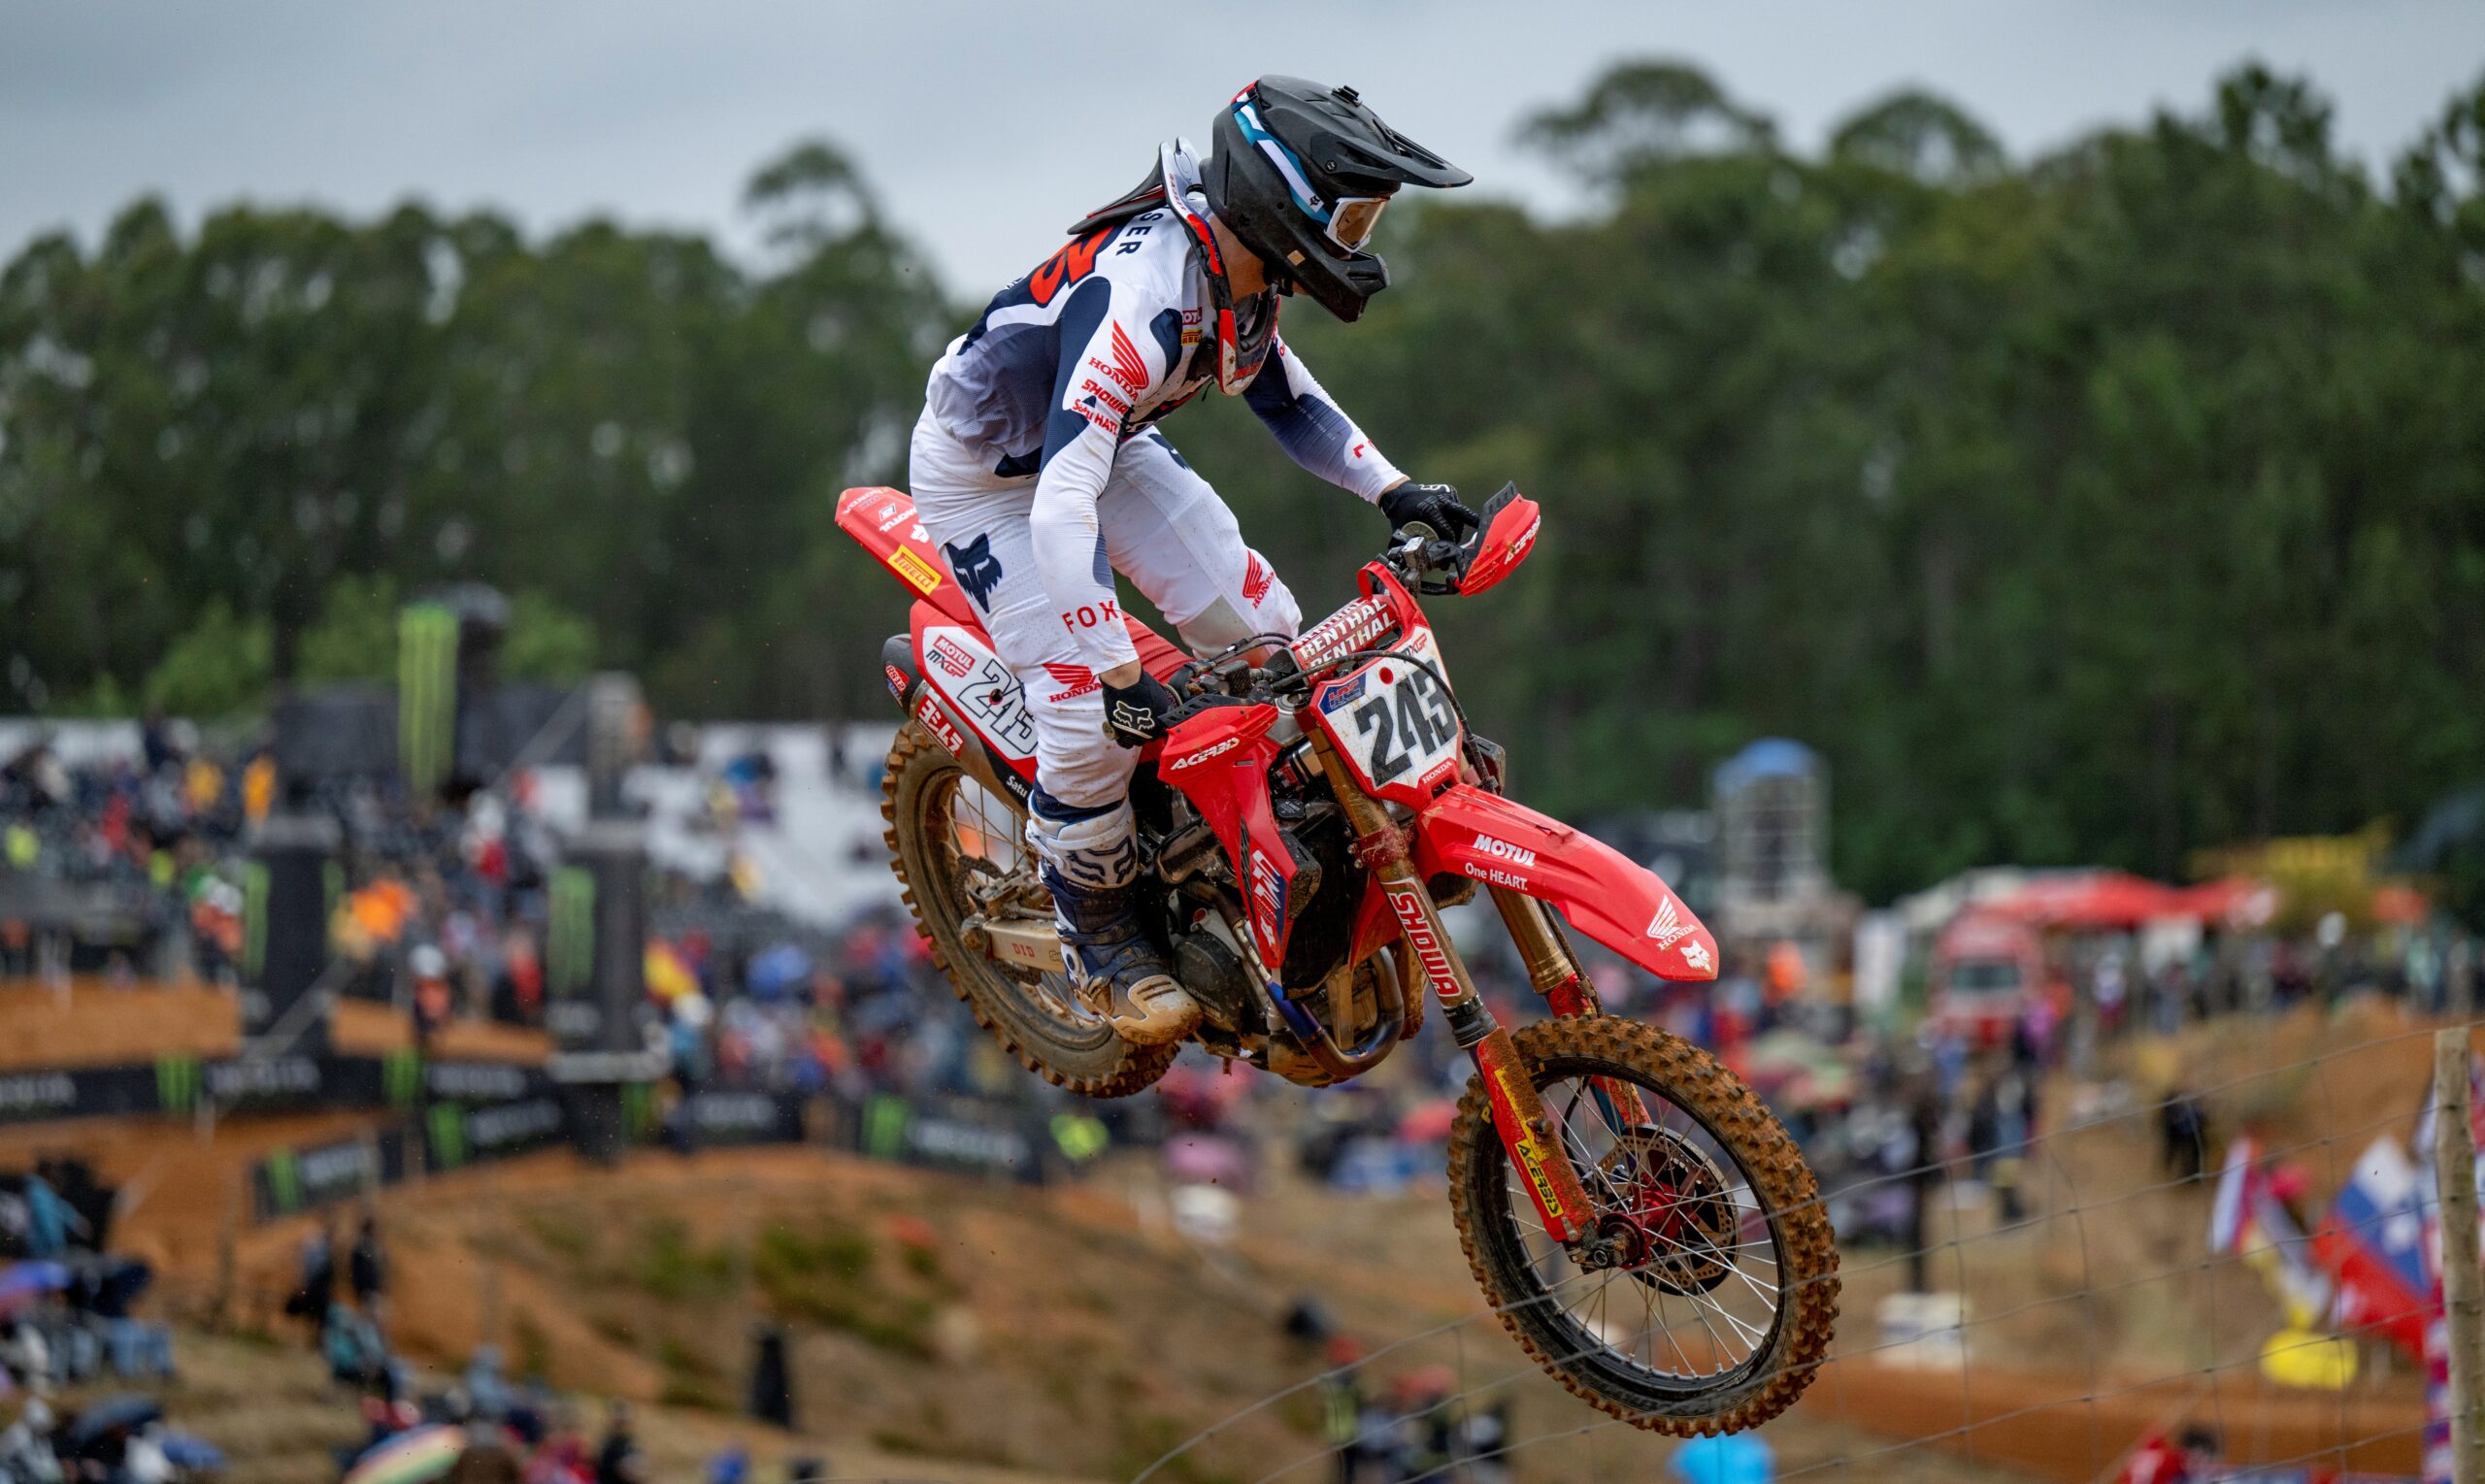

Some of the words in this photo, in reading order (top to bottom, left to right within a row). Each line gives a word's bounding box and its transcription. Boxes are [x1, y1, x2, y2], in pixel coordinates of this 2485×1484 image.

[1116, 210, 1165, 257] SER
[1081, 379, 1129, 414] SHOWA
[1088, 356, 1139, 402] HONDA
[893, 552, 936, 588] PIRELLI
[1062, 600, 1118, 634] FOX
[1299, 598, 1388, 661] RENTHAL
[935, 639, 973, 671] MOTUL
[1049, 681, 1104, 703] HONDA
[1354, 659, 1459, 789] 243
[1006, 775, 1028, 799] Satu
[1422, 760, 1453, 784] HONDA
[1472, 833, 1537, 868] MOTUL
[1465, 861, 1487, 879] One
[1489, 868, 1529, 892] HEART.
[1388, 891, 1462, 998] SHOWA
[1657, 923, 1698, 951] HONDA
